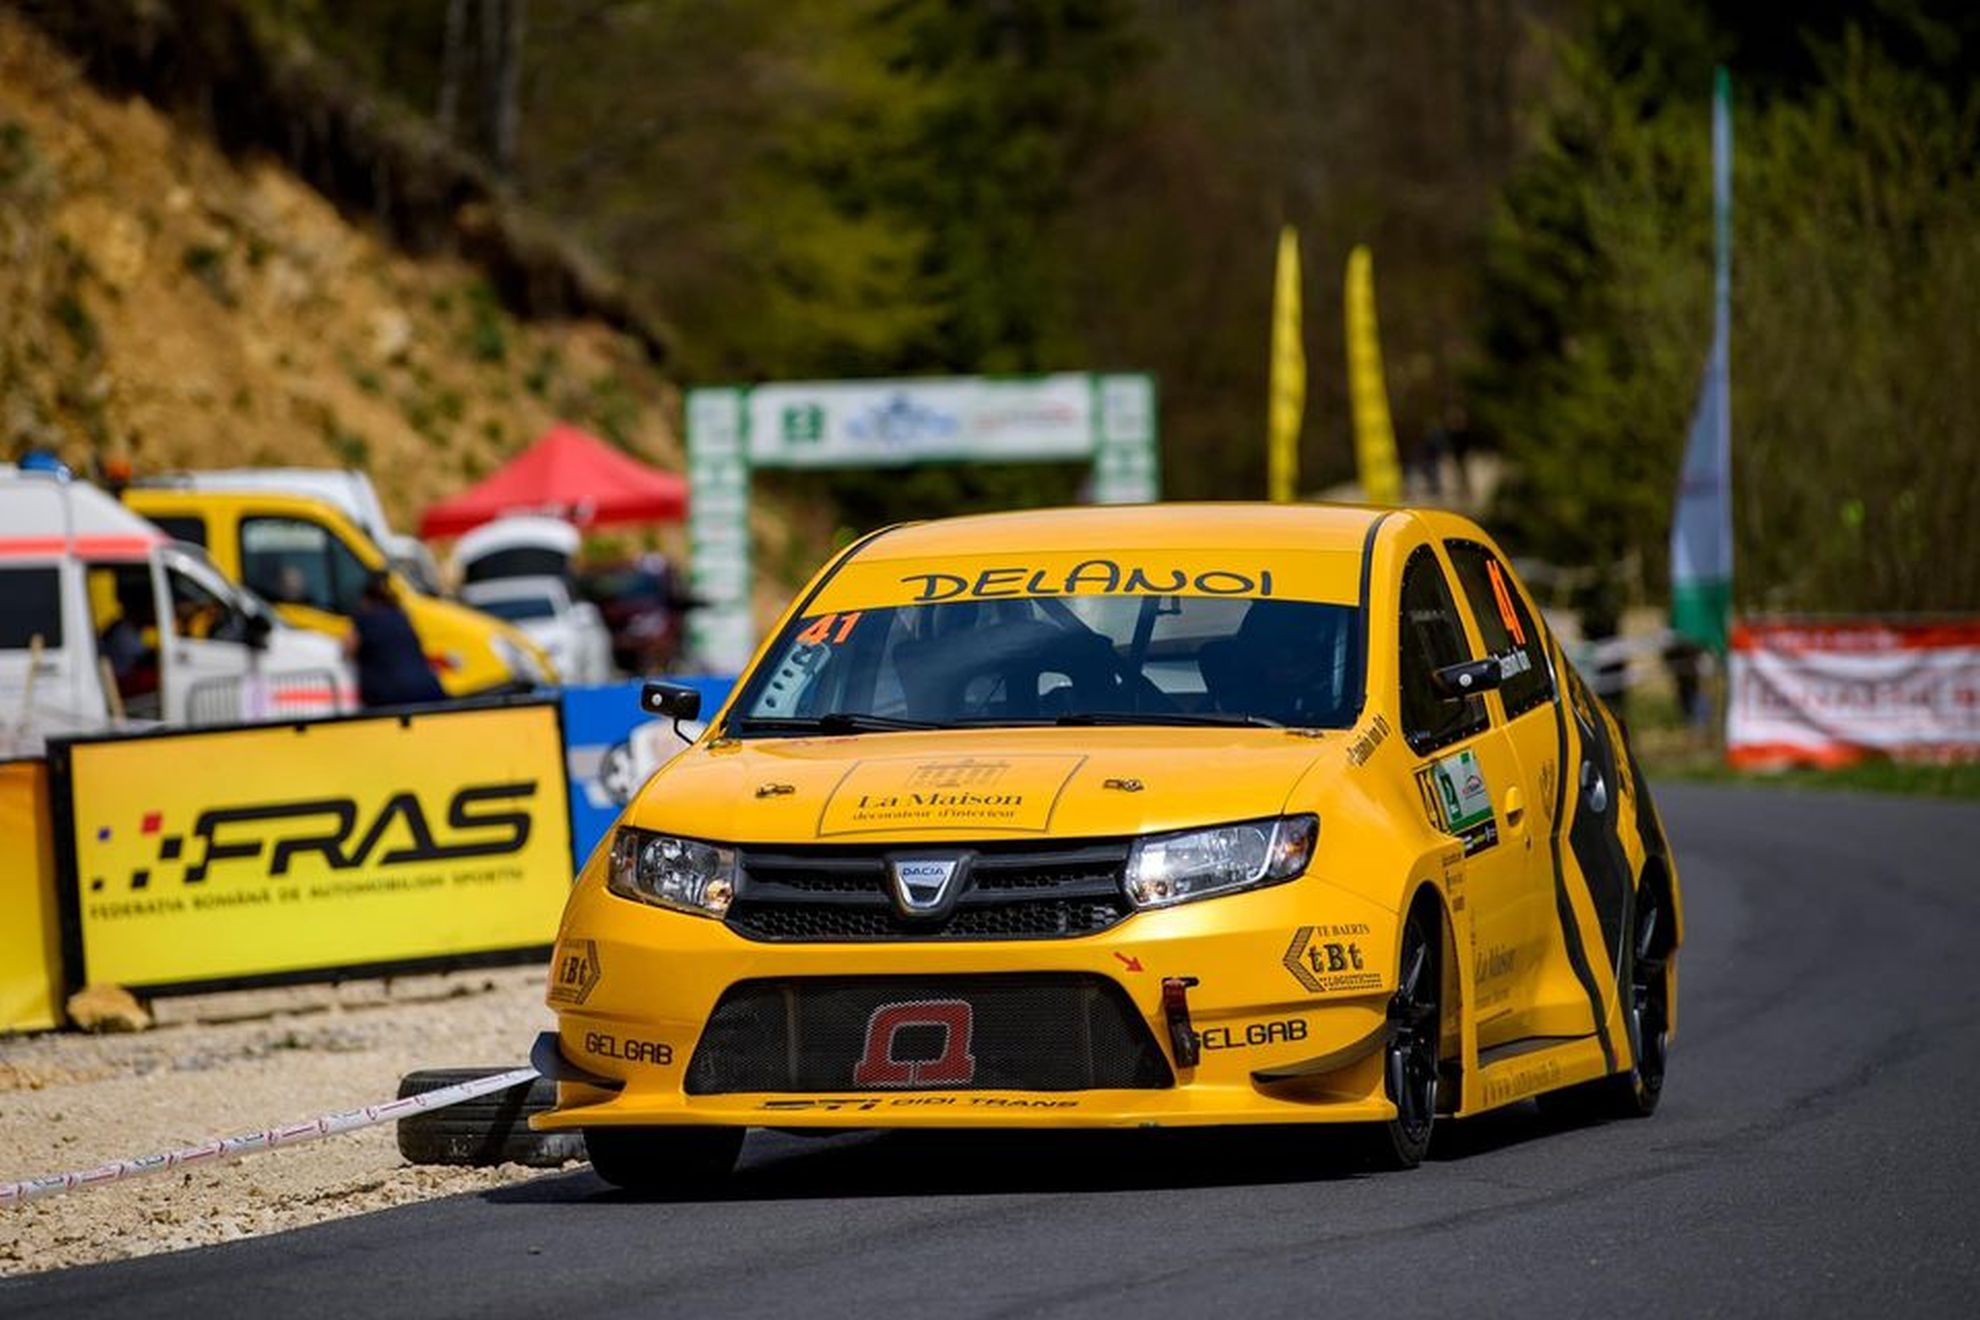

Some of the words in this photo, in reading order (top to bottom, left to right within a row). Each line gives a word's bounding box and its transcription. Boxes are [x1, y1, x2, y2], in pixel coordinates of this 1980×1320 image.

[901, 559, 1272, 601] DELANOI
[795, 610, 862, 646] 41
[858, 795, 899, 809] La
[911, 791, 1023, 807] Maison
[184, 780, 538, 883] FRAS
[902, 867, 945, 876] DACIA
[277, 886, 300, 900] DE
[1307, 942, 1364, 973] tBt
[585, 1032, 673, 1066] GELGAB
[972, 1097, 1079, 1108] TRANS
